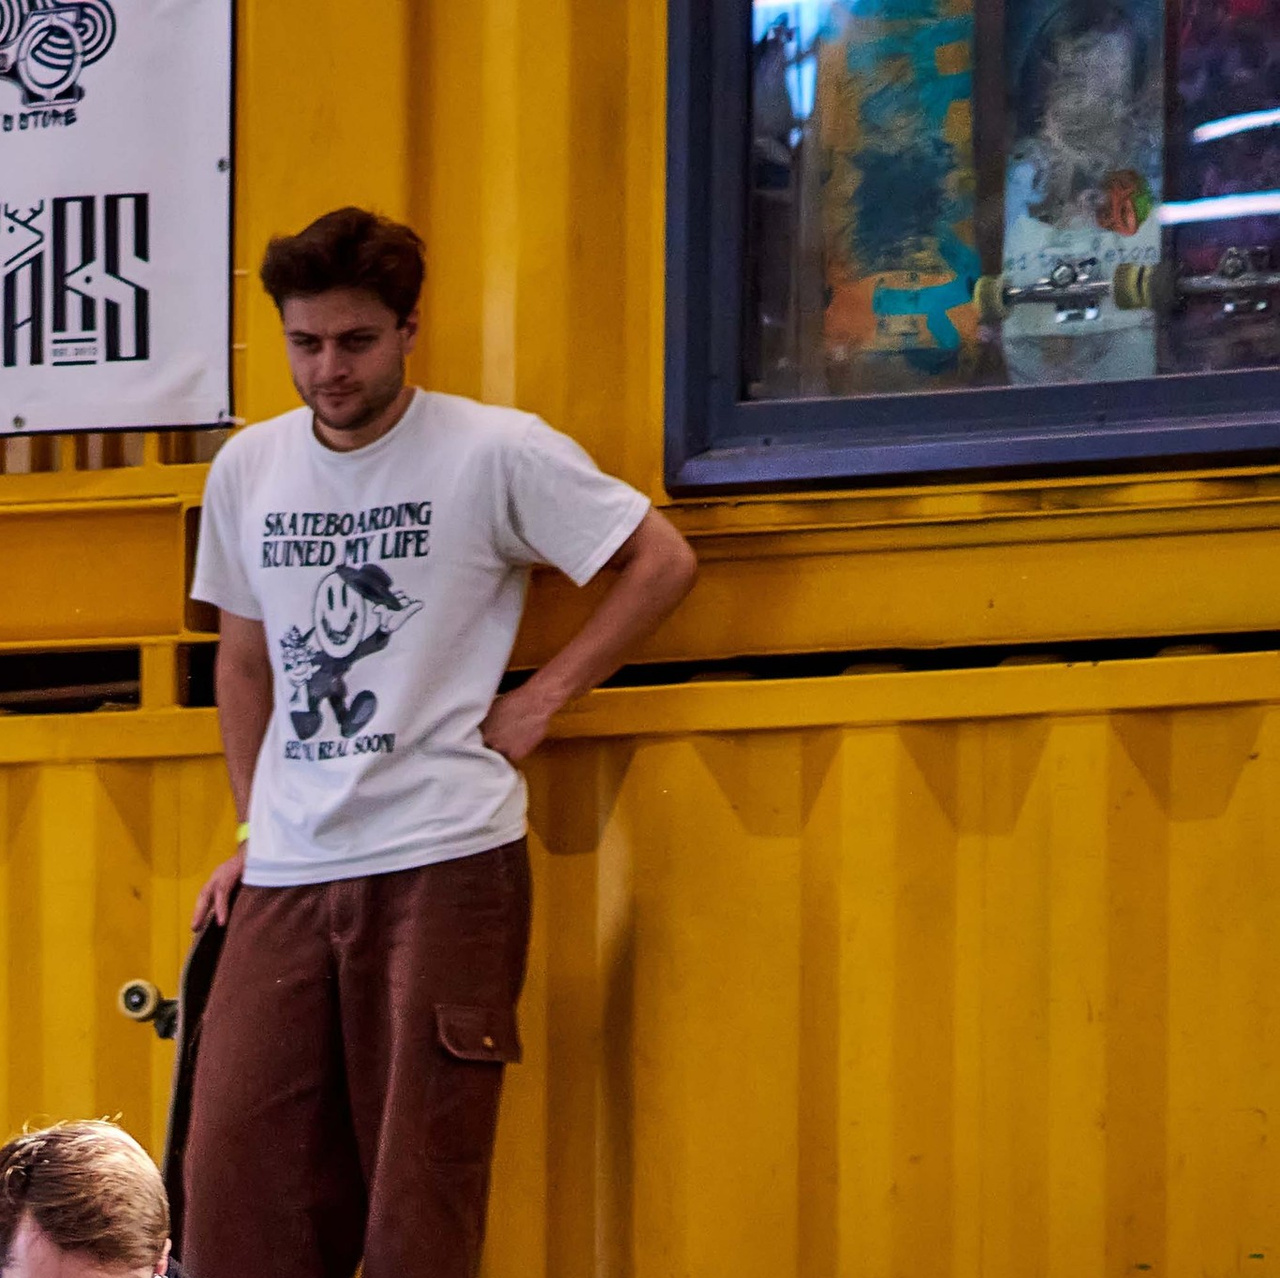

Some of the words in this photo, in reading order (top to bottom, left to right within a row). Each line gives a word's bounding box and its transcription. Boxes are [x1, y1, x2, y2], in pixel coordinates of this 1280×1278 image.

[263, 502, 432, 537] SKATEBOARDING
[343, 534, 375, 565] MY
[381, 530, 429, 559] LIFE
